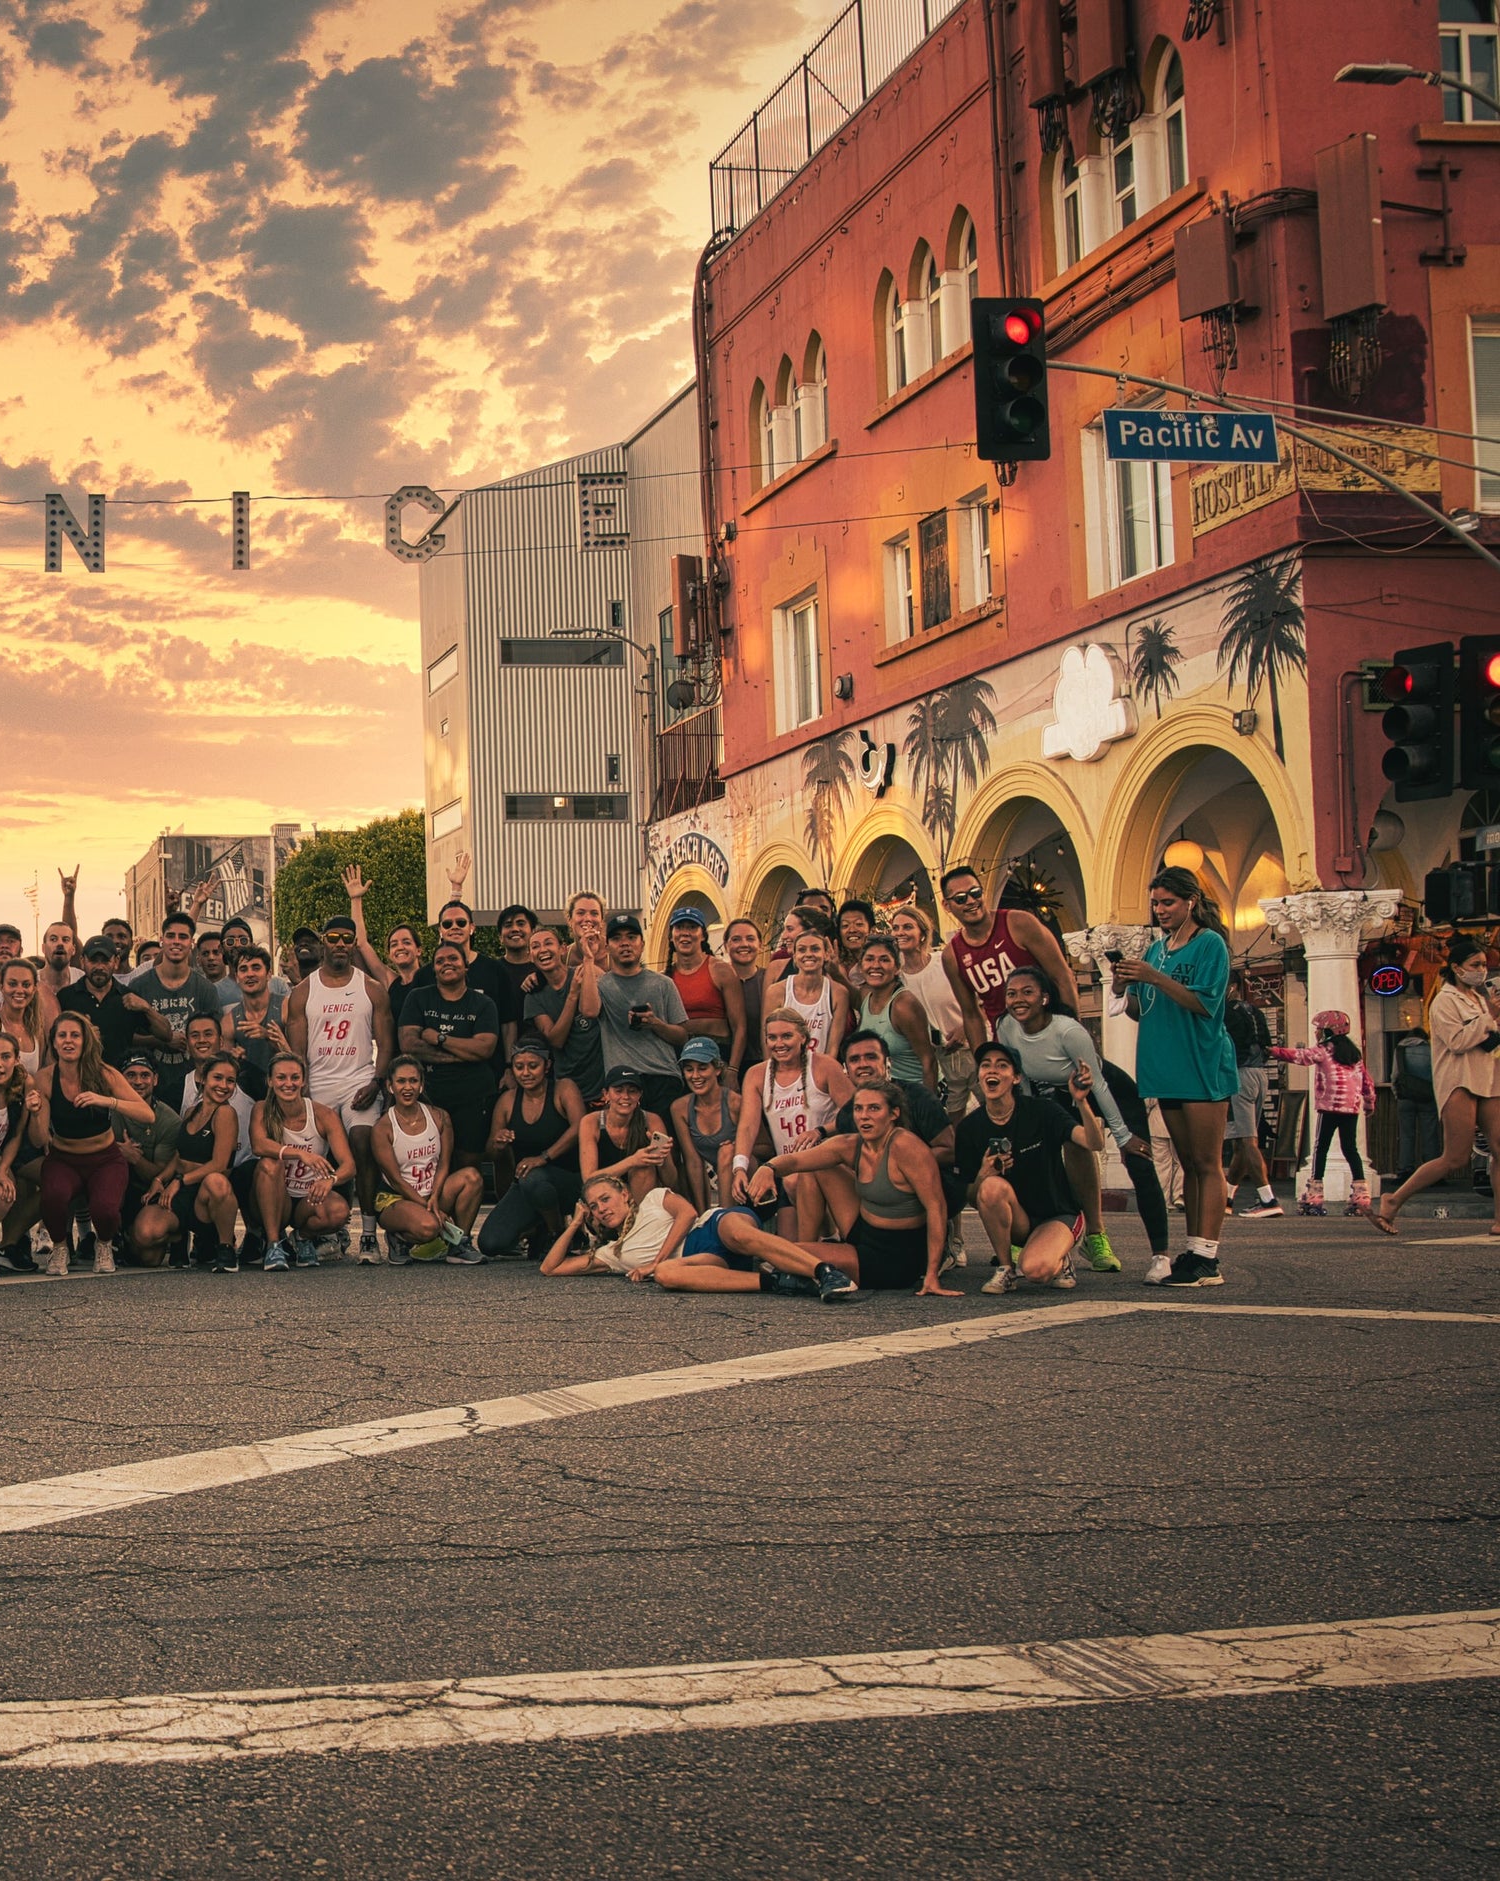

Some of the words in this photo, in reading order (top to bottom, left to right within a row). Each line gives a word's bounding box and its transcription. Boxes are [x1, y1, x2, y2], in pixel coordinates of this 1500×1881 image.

[1119, 420, 1221, 448] Pacific
[1230, 423, 1264, 449] Av
[1192, 463, 1272, 526] HOSTEL
[701, 839, 728, 888] MART
[966, 951, 1017, 994] USA
[1371, 971, 1404, 990] OPEN
[323, 1003, 354, 1013] VENICE
[323, 1020, 351, 1040] 48
[318, 1047, 332, 1057] RUN
[335, 1046, 357, 1056] CLUB
[775, 1094, 806, 1109] VENICE
[780, 1114, 807, 1138] 48
[407, 1143, 436, 1160] VENICE
[411, 1161, 434, 1184] 48
